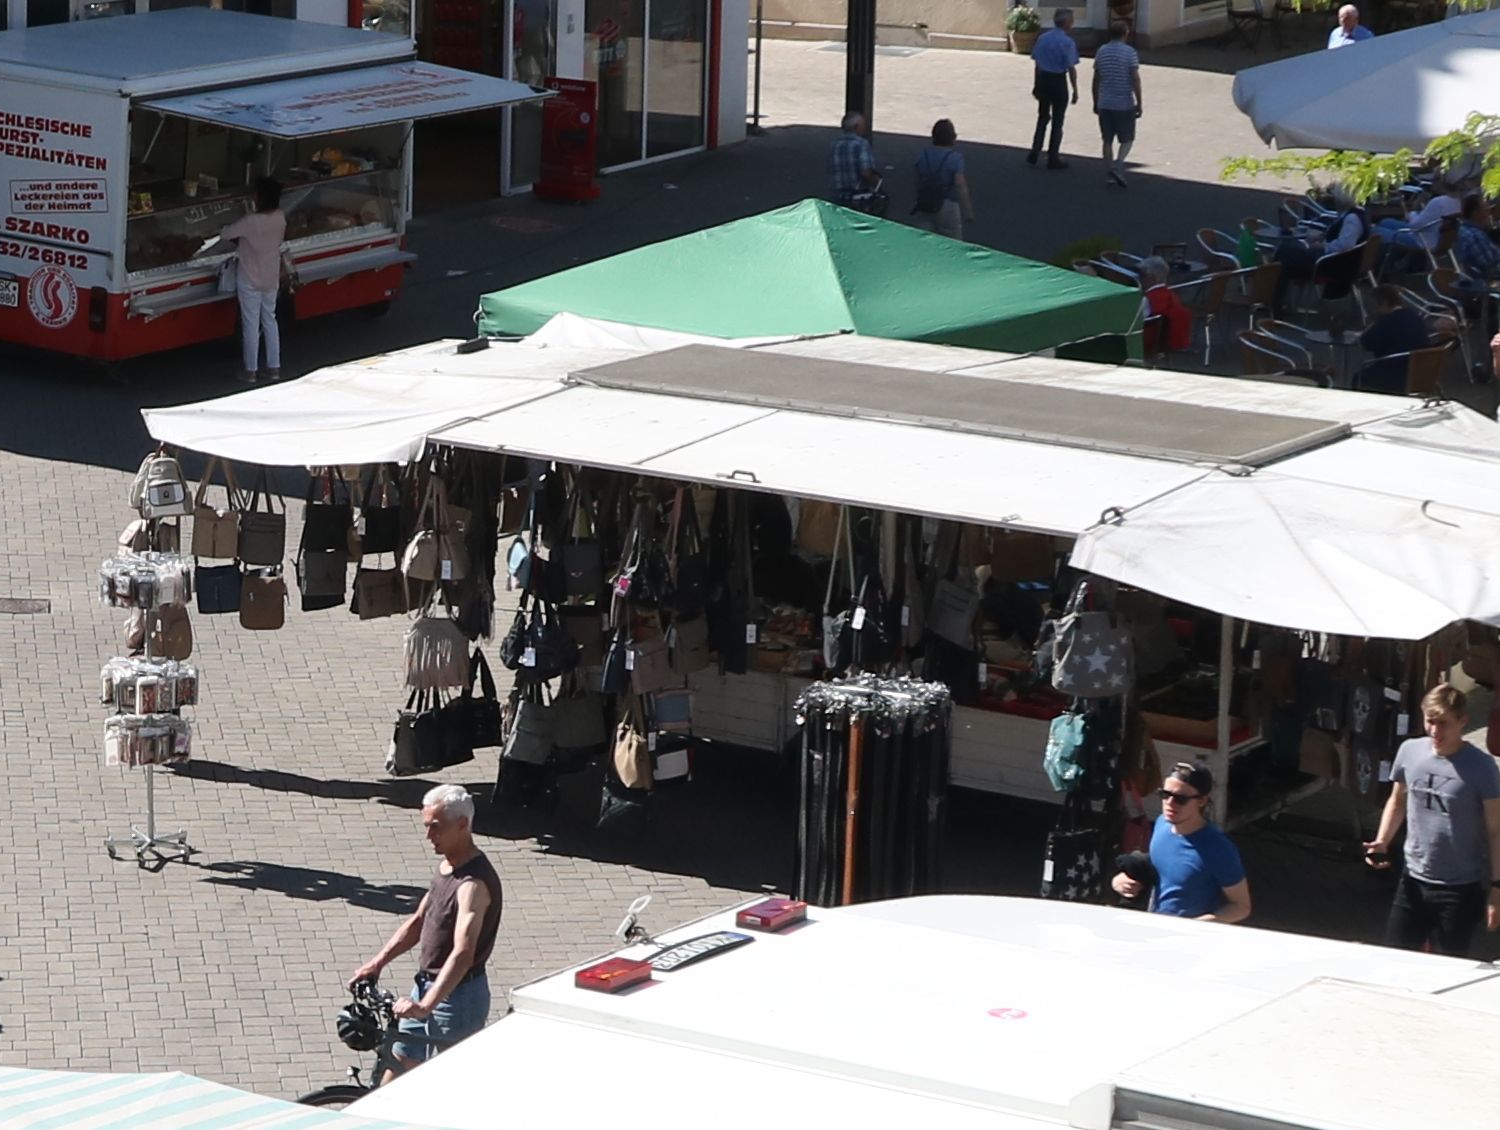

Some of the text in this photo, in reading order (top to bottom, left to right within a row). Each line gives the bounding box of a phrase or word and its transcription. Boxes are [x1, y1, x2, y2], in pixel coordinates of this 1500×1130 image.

[55, 181, 98, 191] andere
[14, 192, 105, 202] Leckereien aus
[25, 201, 92, 211] der Heimat
[5, 217, 90, 244] SZARKO
